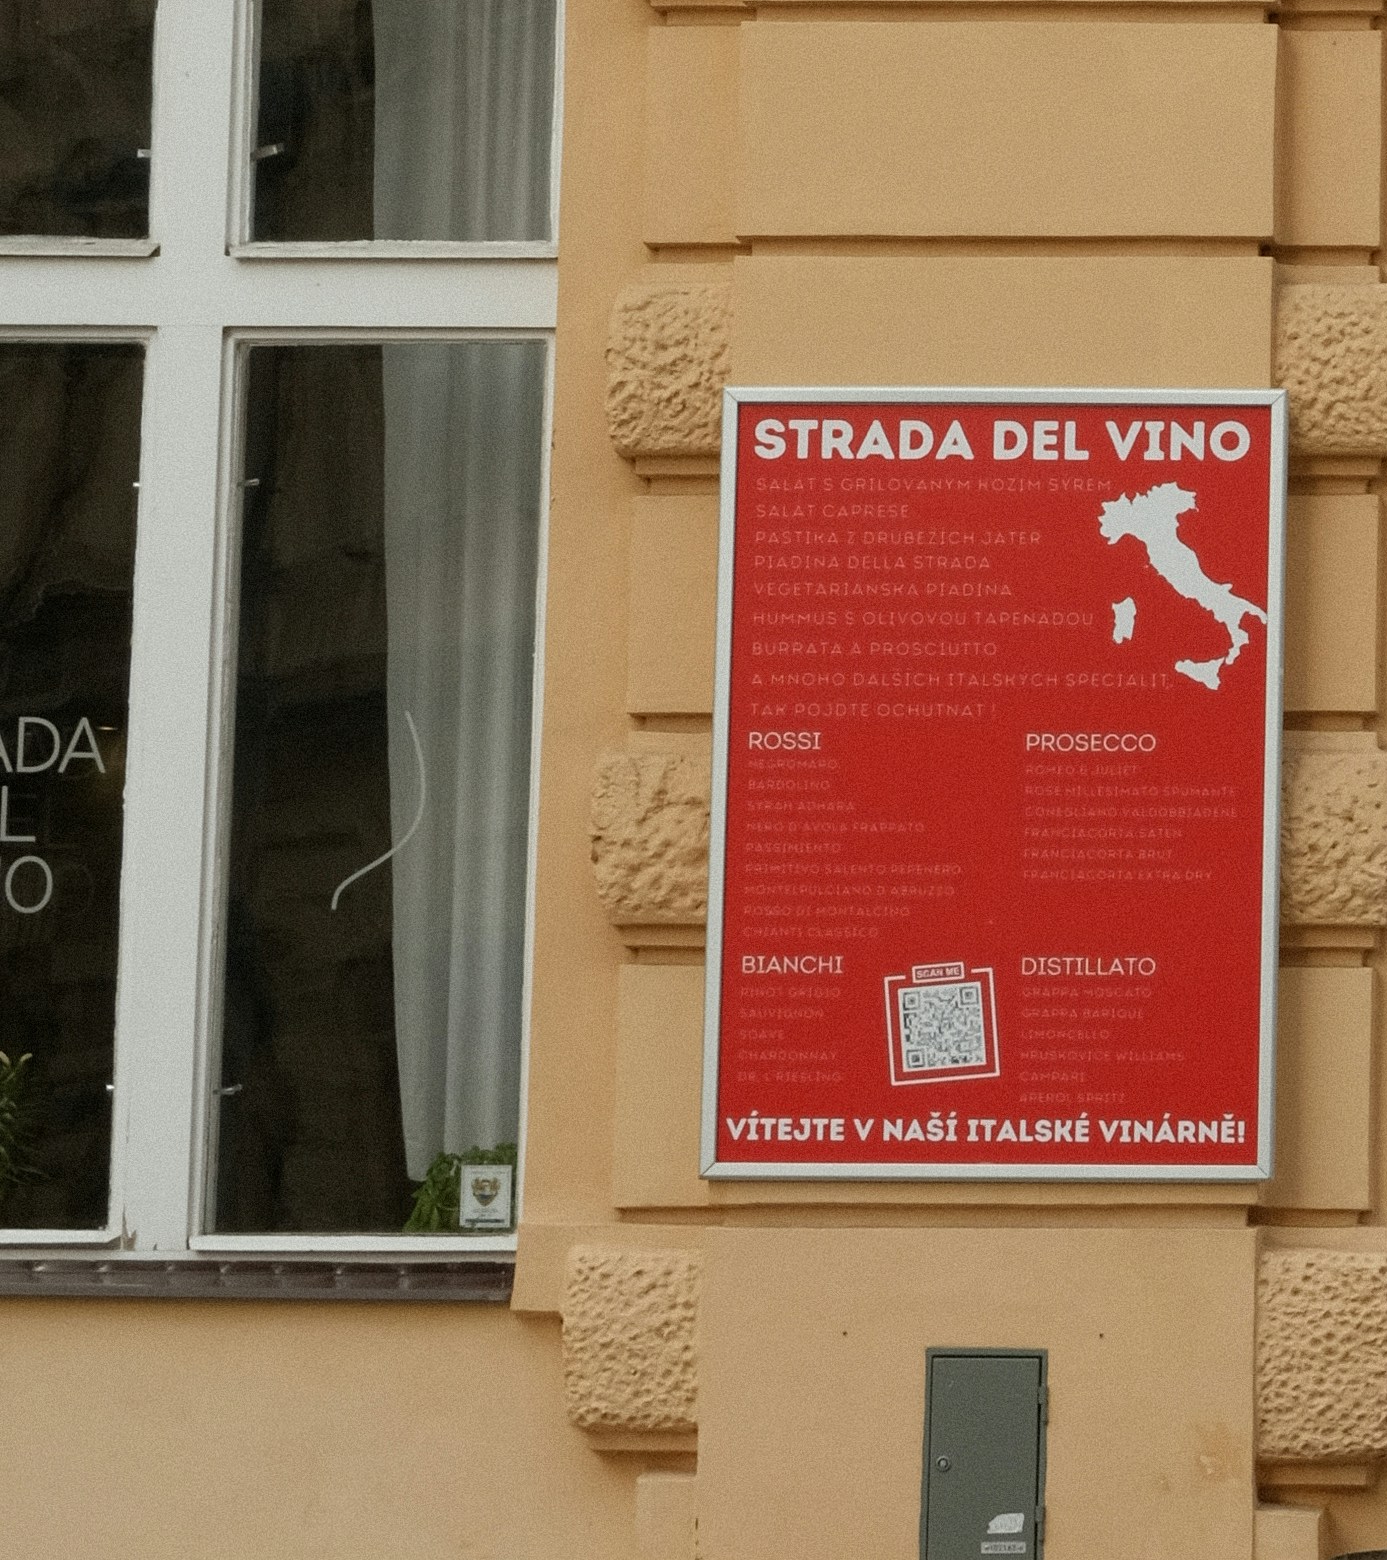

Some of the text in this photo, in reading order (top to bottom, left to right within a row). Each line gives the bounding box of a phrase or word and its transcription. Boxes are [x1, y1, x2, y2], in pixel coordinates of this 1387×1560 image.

[753, 417, 1251, 462] STRADA DEL VINO
[823, 477, 834, 491] S
[823, 504, 909, 518] CAPRESE
[754, 555, 992, 570] PIADINA DELLA STRADA
[926, 582, 1012, 597] PIADINA
[753, 611, 1094, 626] HUMMUS S OLIVOVOU TAPENADOU
[752, 642, 998, 656] BURRATA A PROSCIUTTO
[751, 673, 763, 687] A
[771, 673, 846, 687] MNOHO
[750, 703, 787, 717] TAK
[748, 732, 821, 750] ROSSI
[1026, 733, 1157, 752] PROSECCO
[741, 955, 844, 975] BIANCHI
[1021, 957, 1157, 976] DISTILLATO
[726, 1111, 1246, 1144] VÍTEJTE V NAŠÍ ITALSKÉ VINÁRNĚ!
